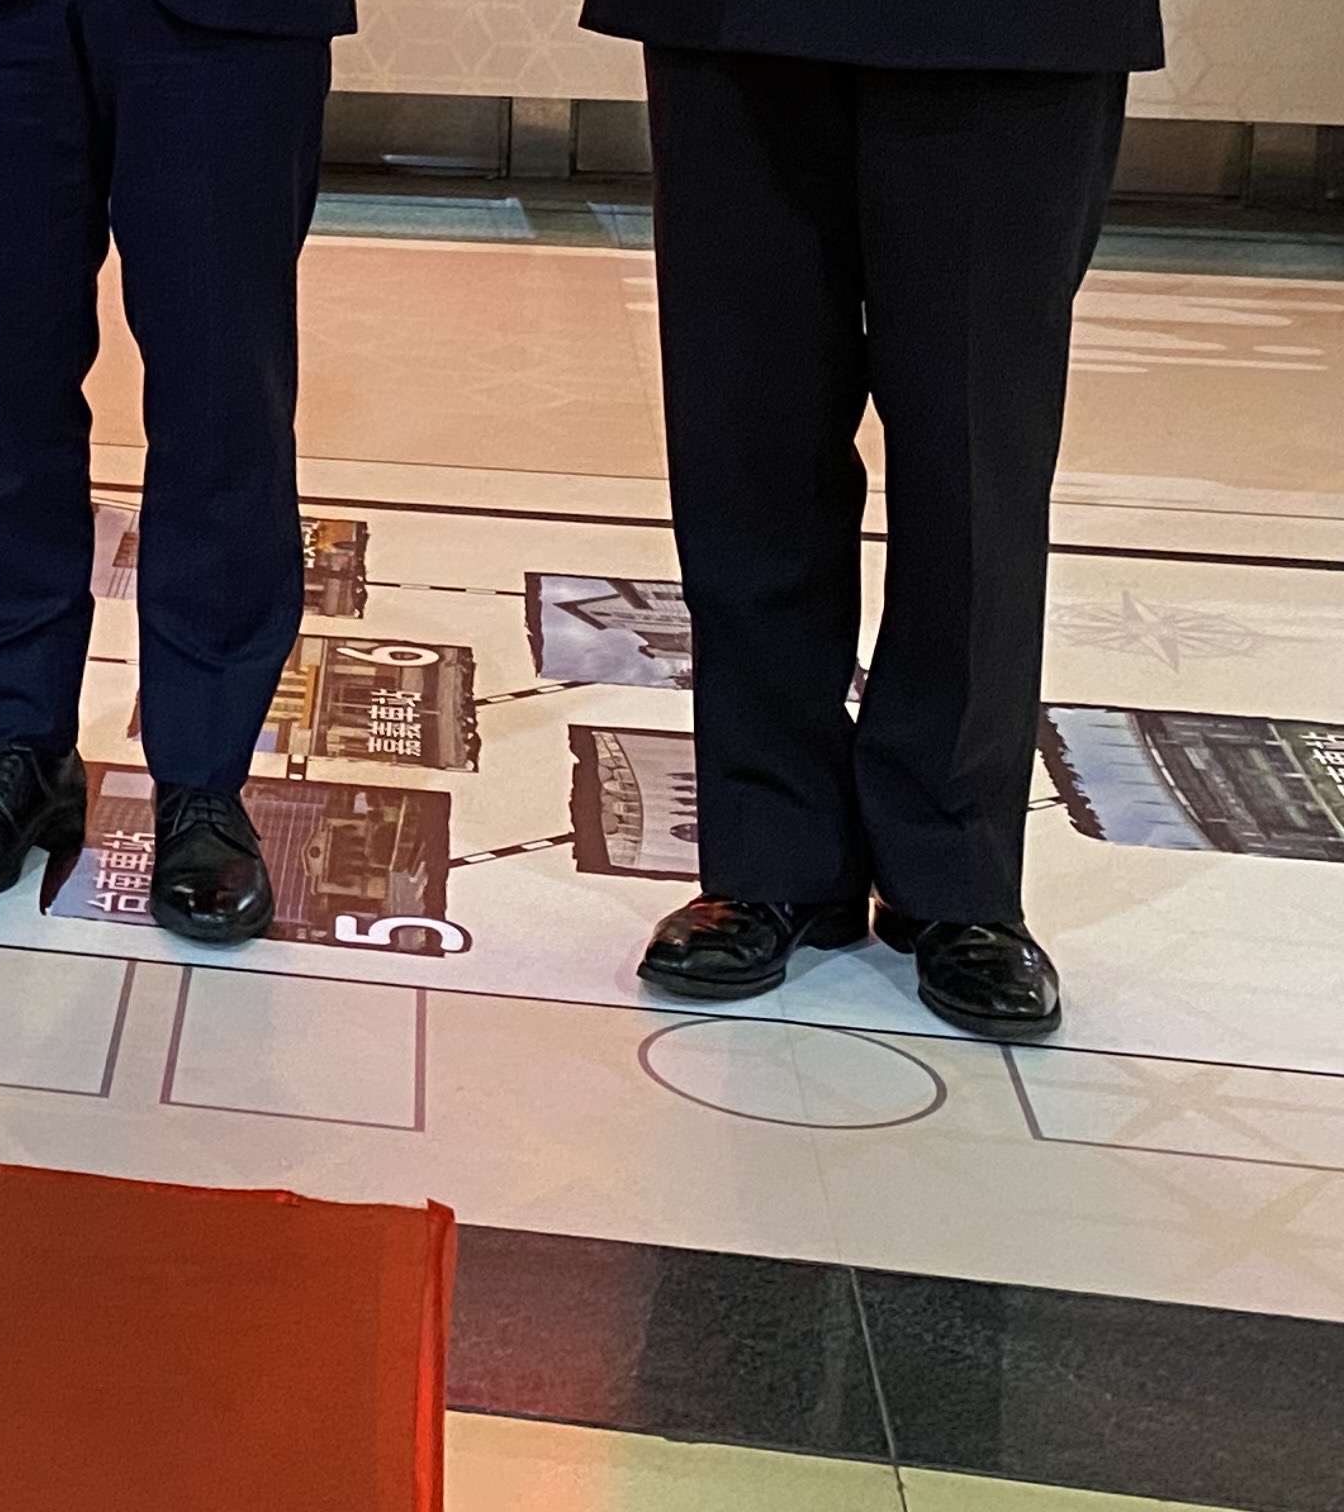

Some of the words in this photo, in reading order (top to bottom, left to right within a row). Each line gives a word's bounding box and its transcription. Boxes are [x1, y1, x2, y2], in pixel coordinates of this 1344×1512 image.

[367, 687, 423, 758] 嘉義車站
[334, 914, 466, 953] 5
